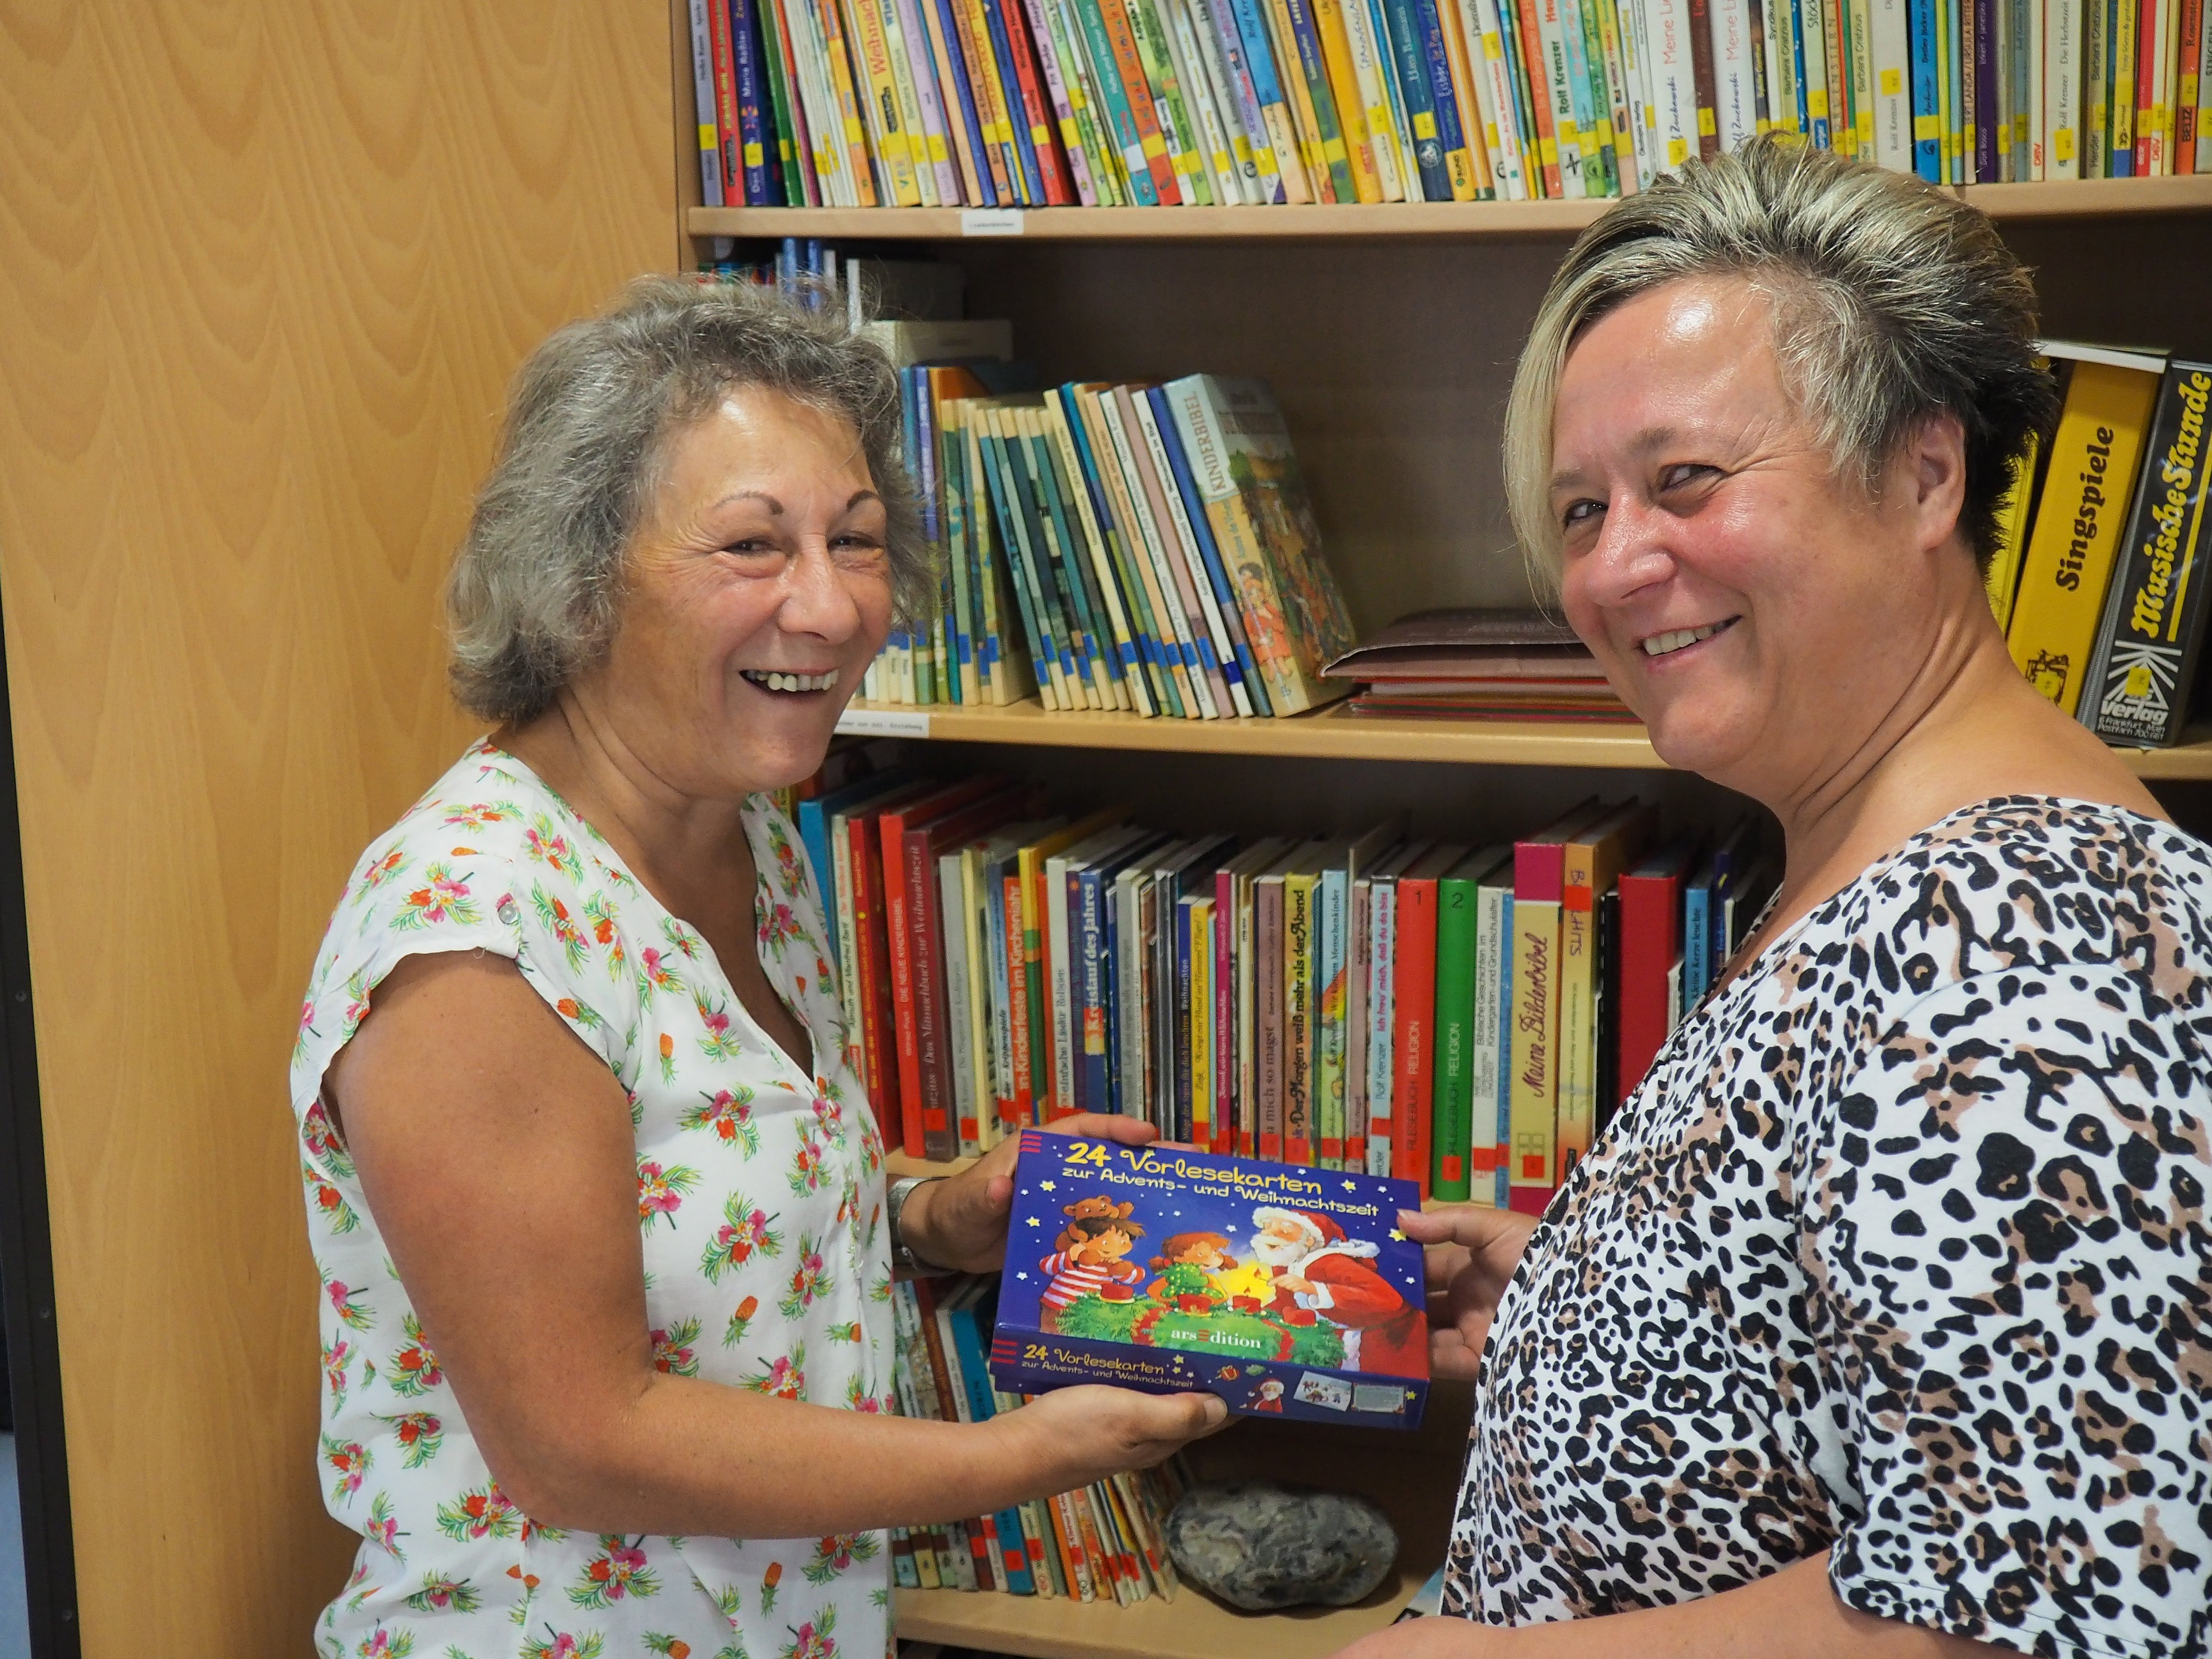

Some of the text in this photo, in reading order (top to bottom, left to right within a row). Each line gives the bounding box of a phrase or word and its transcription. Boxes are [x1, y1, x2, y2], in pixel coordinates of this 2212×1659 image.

[1662, 20, 1677, 64] Meine
[1726, 15, 1739, 60] Meine
[1551, 41, 1570, 114] Rolf Krenzer
[1783, 58, 1792, 96] Barbara
[1856, 55, 1866, 93] Barbara
[2059, 111, 2068, 129] Rolf
[2183, 107, 2192, 142] BELTZ
[2090, 134, 2099, 168] Herder
[1183, 391, 1227, 492] KINDERBIBEL
[2055, 426, 2114, 592] Singspiele
[2130, 371, 2212, 639] Musische Stunde
[1083, 883, 1100, 934] Jahres
[1378, 892, 1388, 910] bist
[1379, 912, 1387, 925] da
[1452, 892, 1463, 909] 2
[1331, 889, 1340, 960] Menschenkinder
[1378, 927, 1387, 939] du
[1691, 908, 1701, 940] leuchte
[1084, 934, 1096, 959] des
[1377, 943, 1386, 961] daß
[846, 981, 854, 996] und
[1013, 969, 1024, 988] im
[1475, 934, 1487, 1046] Biblische Geschichten im
[1691, 971, 1700, 999] Kleine
[1289, 890, 1308, 1121] Der Morgen weiß mehr als der Abend
[1518, 932, 1548, 1098] Meine Bilderbibel
[1265, 1026, 1280, 1065] magst
[1374, 1043, 1385, 1079] Krenzer
[1408, 1020, 1419, 1075] RELIGION
[1448, 1023, 1460, 1077] RELIGION
[1267, 1070, 1275, 1083] so
[1375, 1081, 1385, 1099] Rolf
[1263, 1088, 1275, 1121] mich
[1064, 1142, 1322, 1195] 24 Vorlesekarten
[1061, 1166, 1380, 1217] zur Advents- und Weihnachtszeit
[1022, 1360, 1194, 1389] zur Advents- und Weihnachtszeit
[1023, 1343, 1165, 1375] 24 Vorlesekarten
